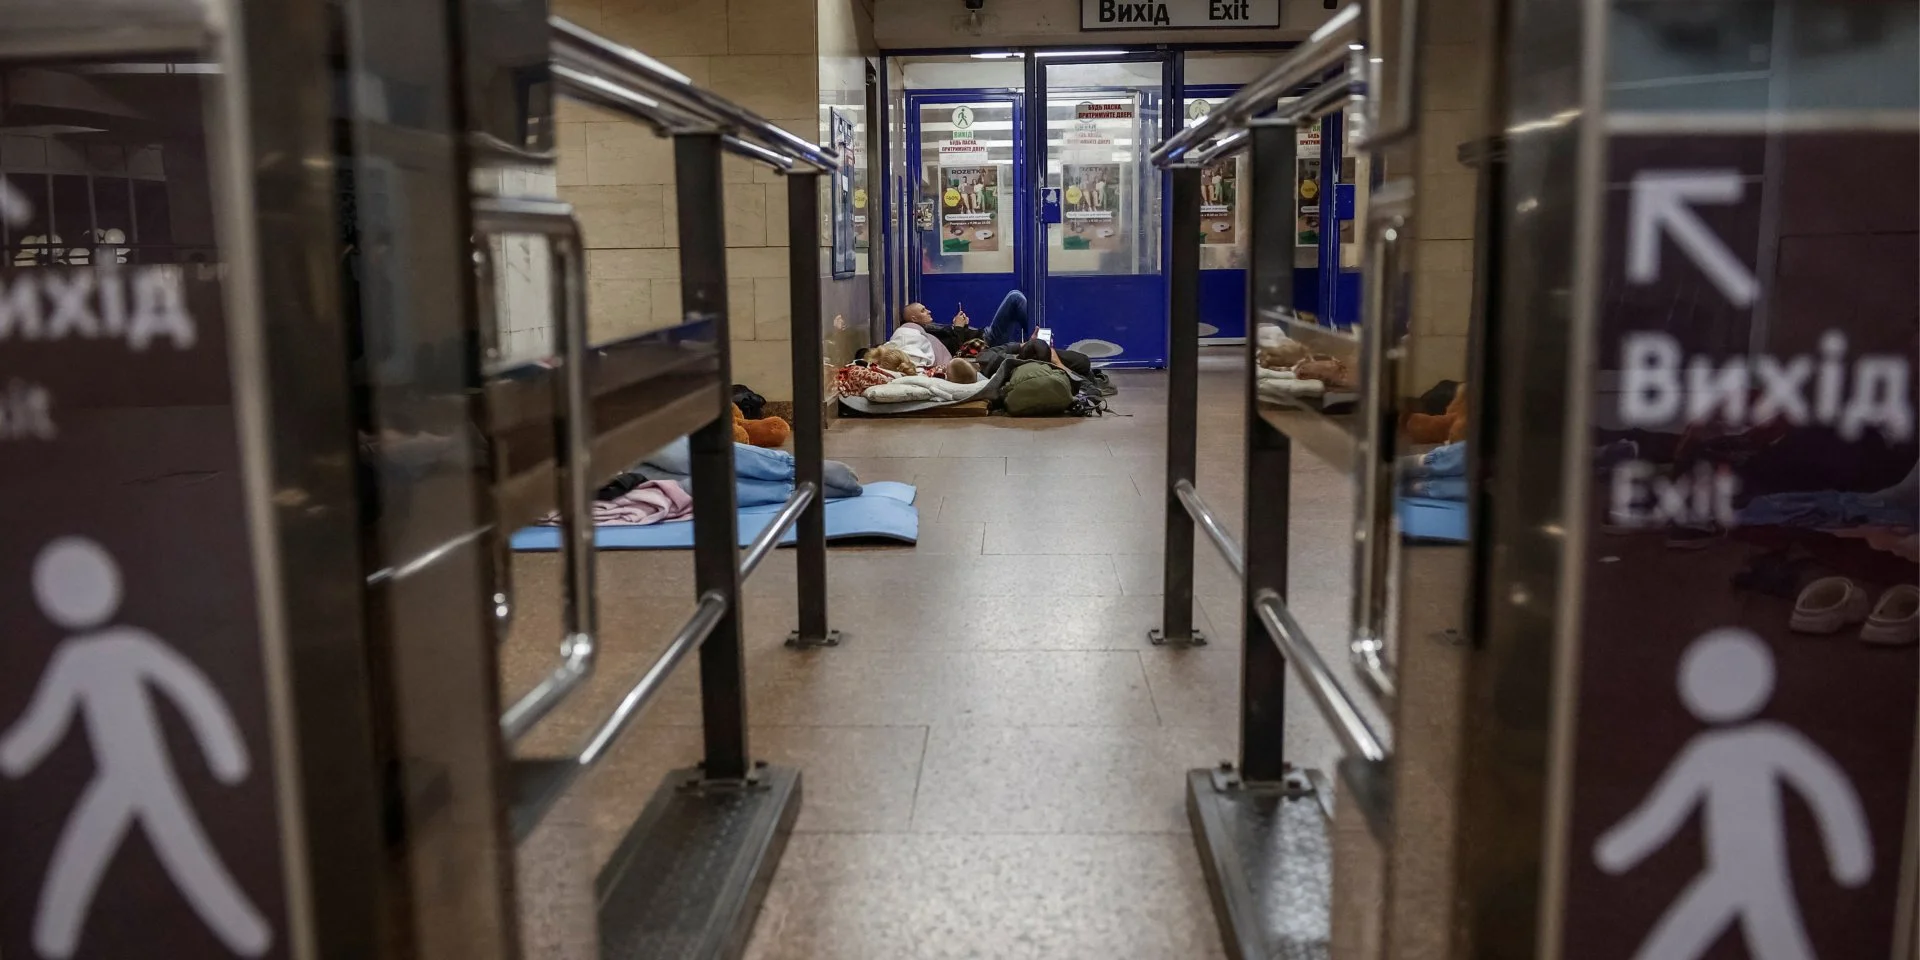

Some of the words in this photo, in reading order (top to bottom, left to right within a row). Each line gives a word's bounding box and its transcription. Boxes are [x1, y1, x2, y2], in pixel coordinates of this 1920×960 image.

[1100, 0, 1170, 26] Вихід
[1209, 0, 1249, 21] Exit
[1618, 329, 1912, 443] Вихід
[1611, 460, 1742, 529] Exit
